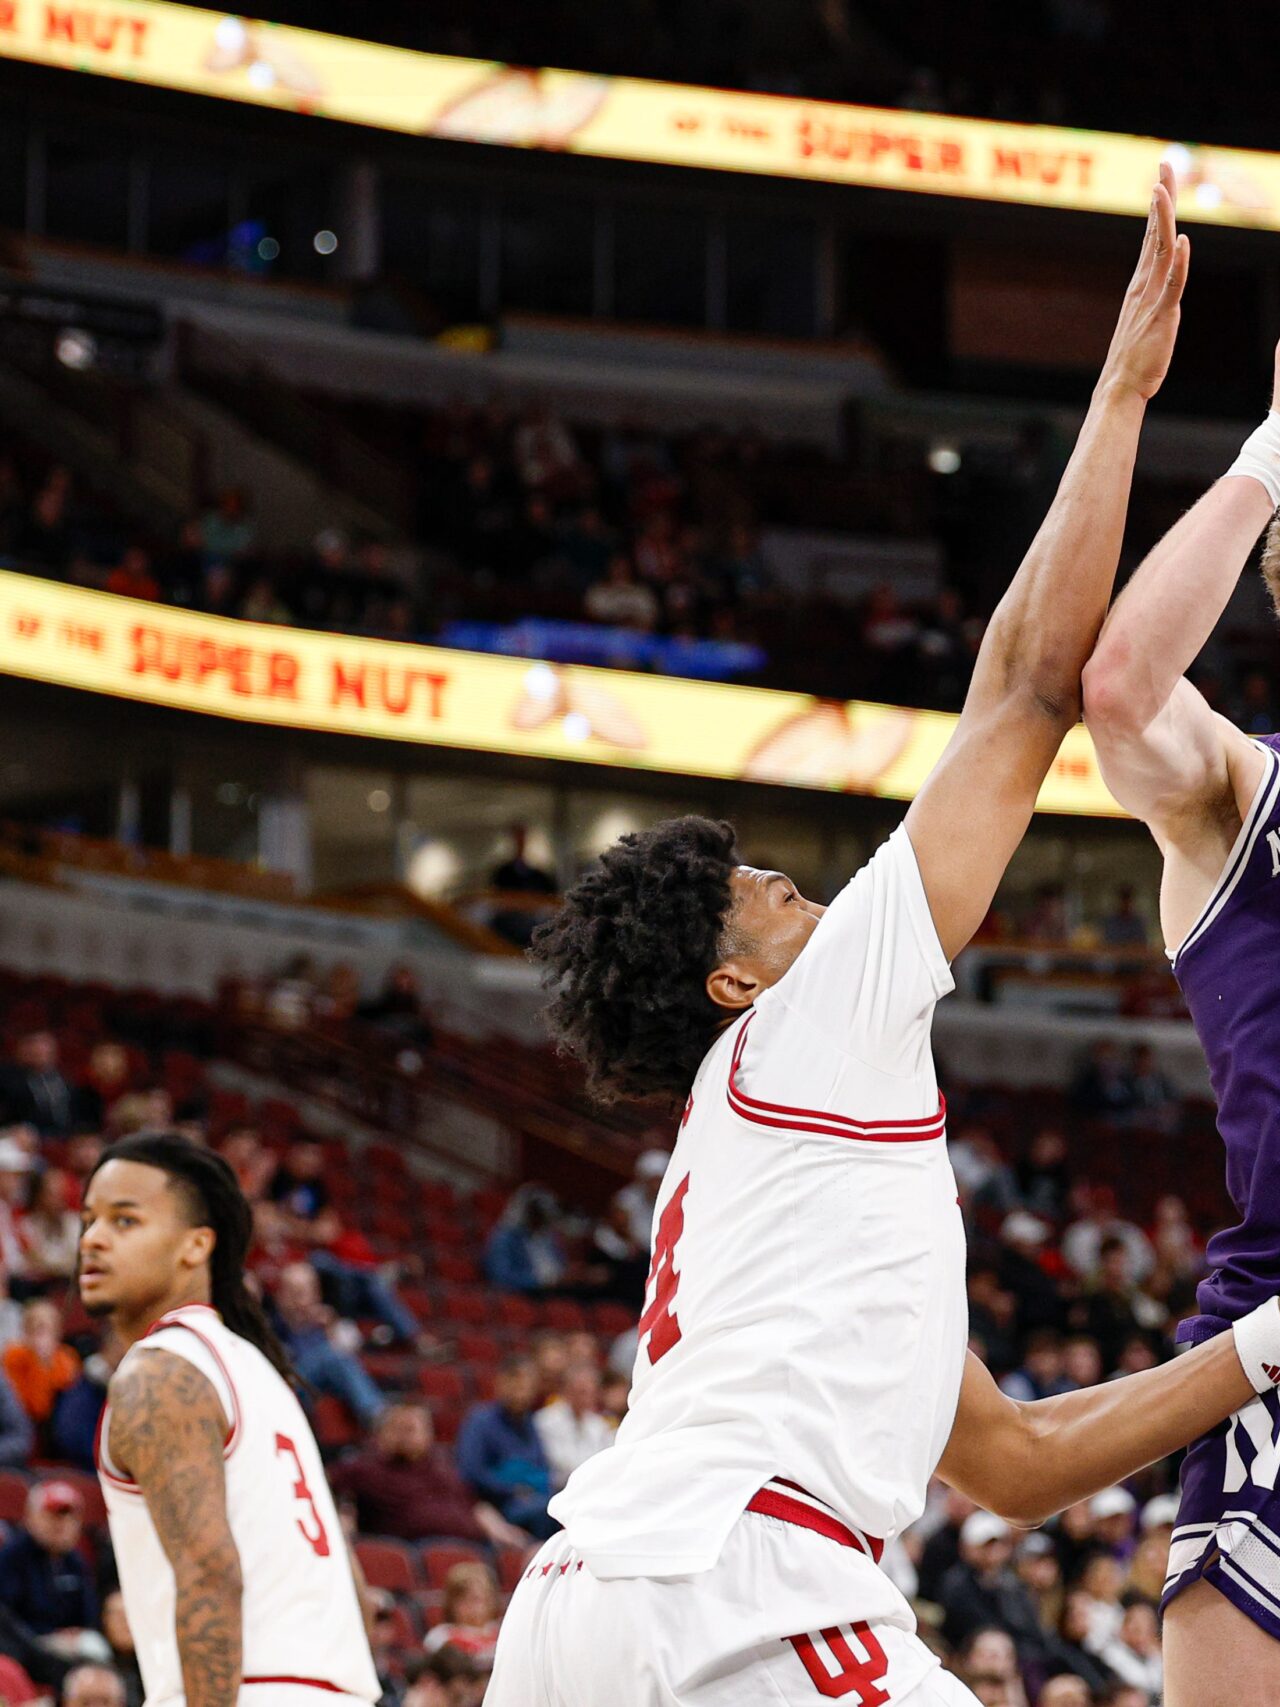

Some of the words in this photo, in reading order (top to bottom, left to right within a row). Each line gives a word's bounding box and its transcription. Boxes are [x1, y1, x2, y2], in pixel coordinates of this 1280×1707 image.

[800, 119, 962, 173] SUPER
[994, 144, 1092, 189] NUT
[132, 625, 299, 699] SUPER
[331, 658, 448, 718] NUT
[275, 1433, 330, 1557] 3
